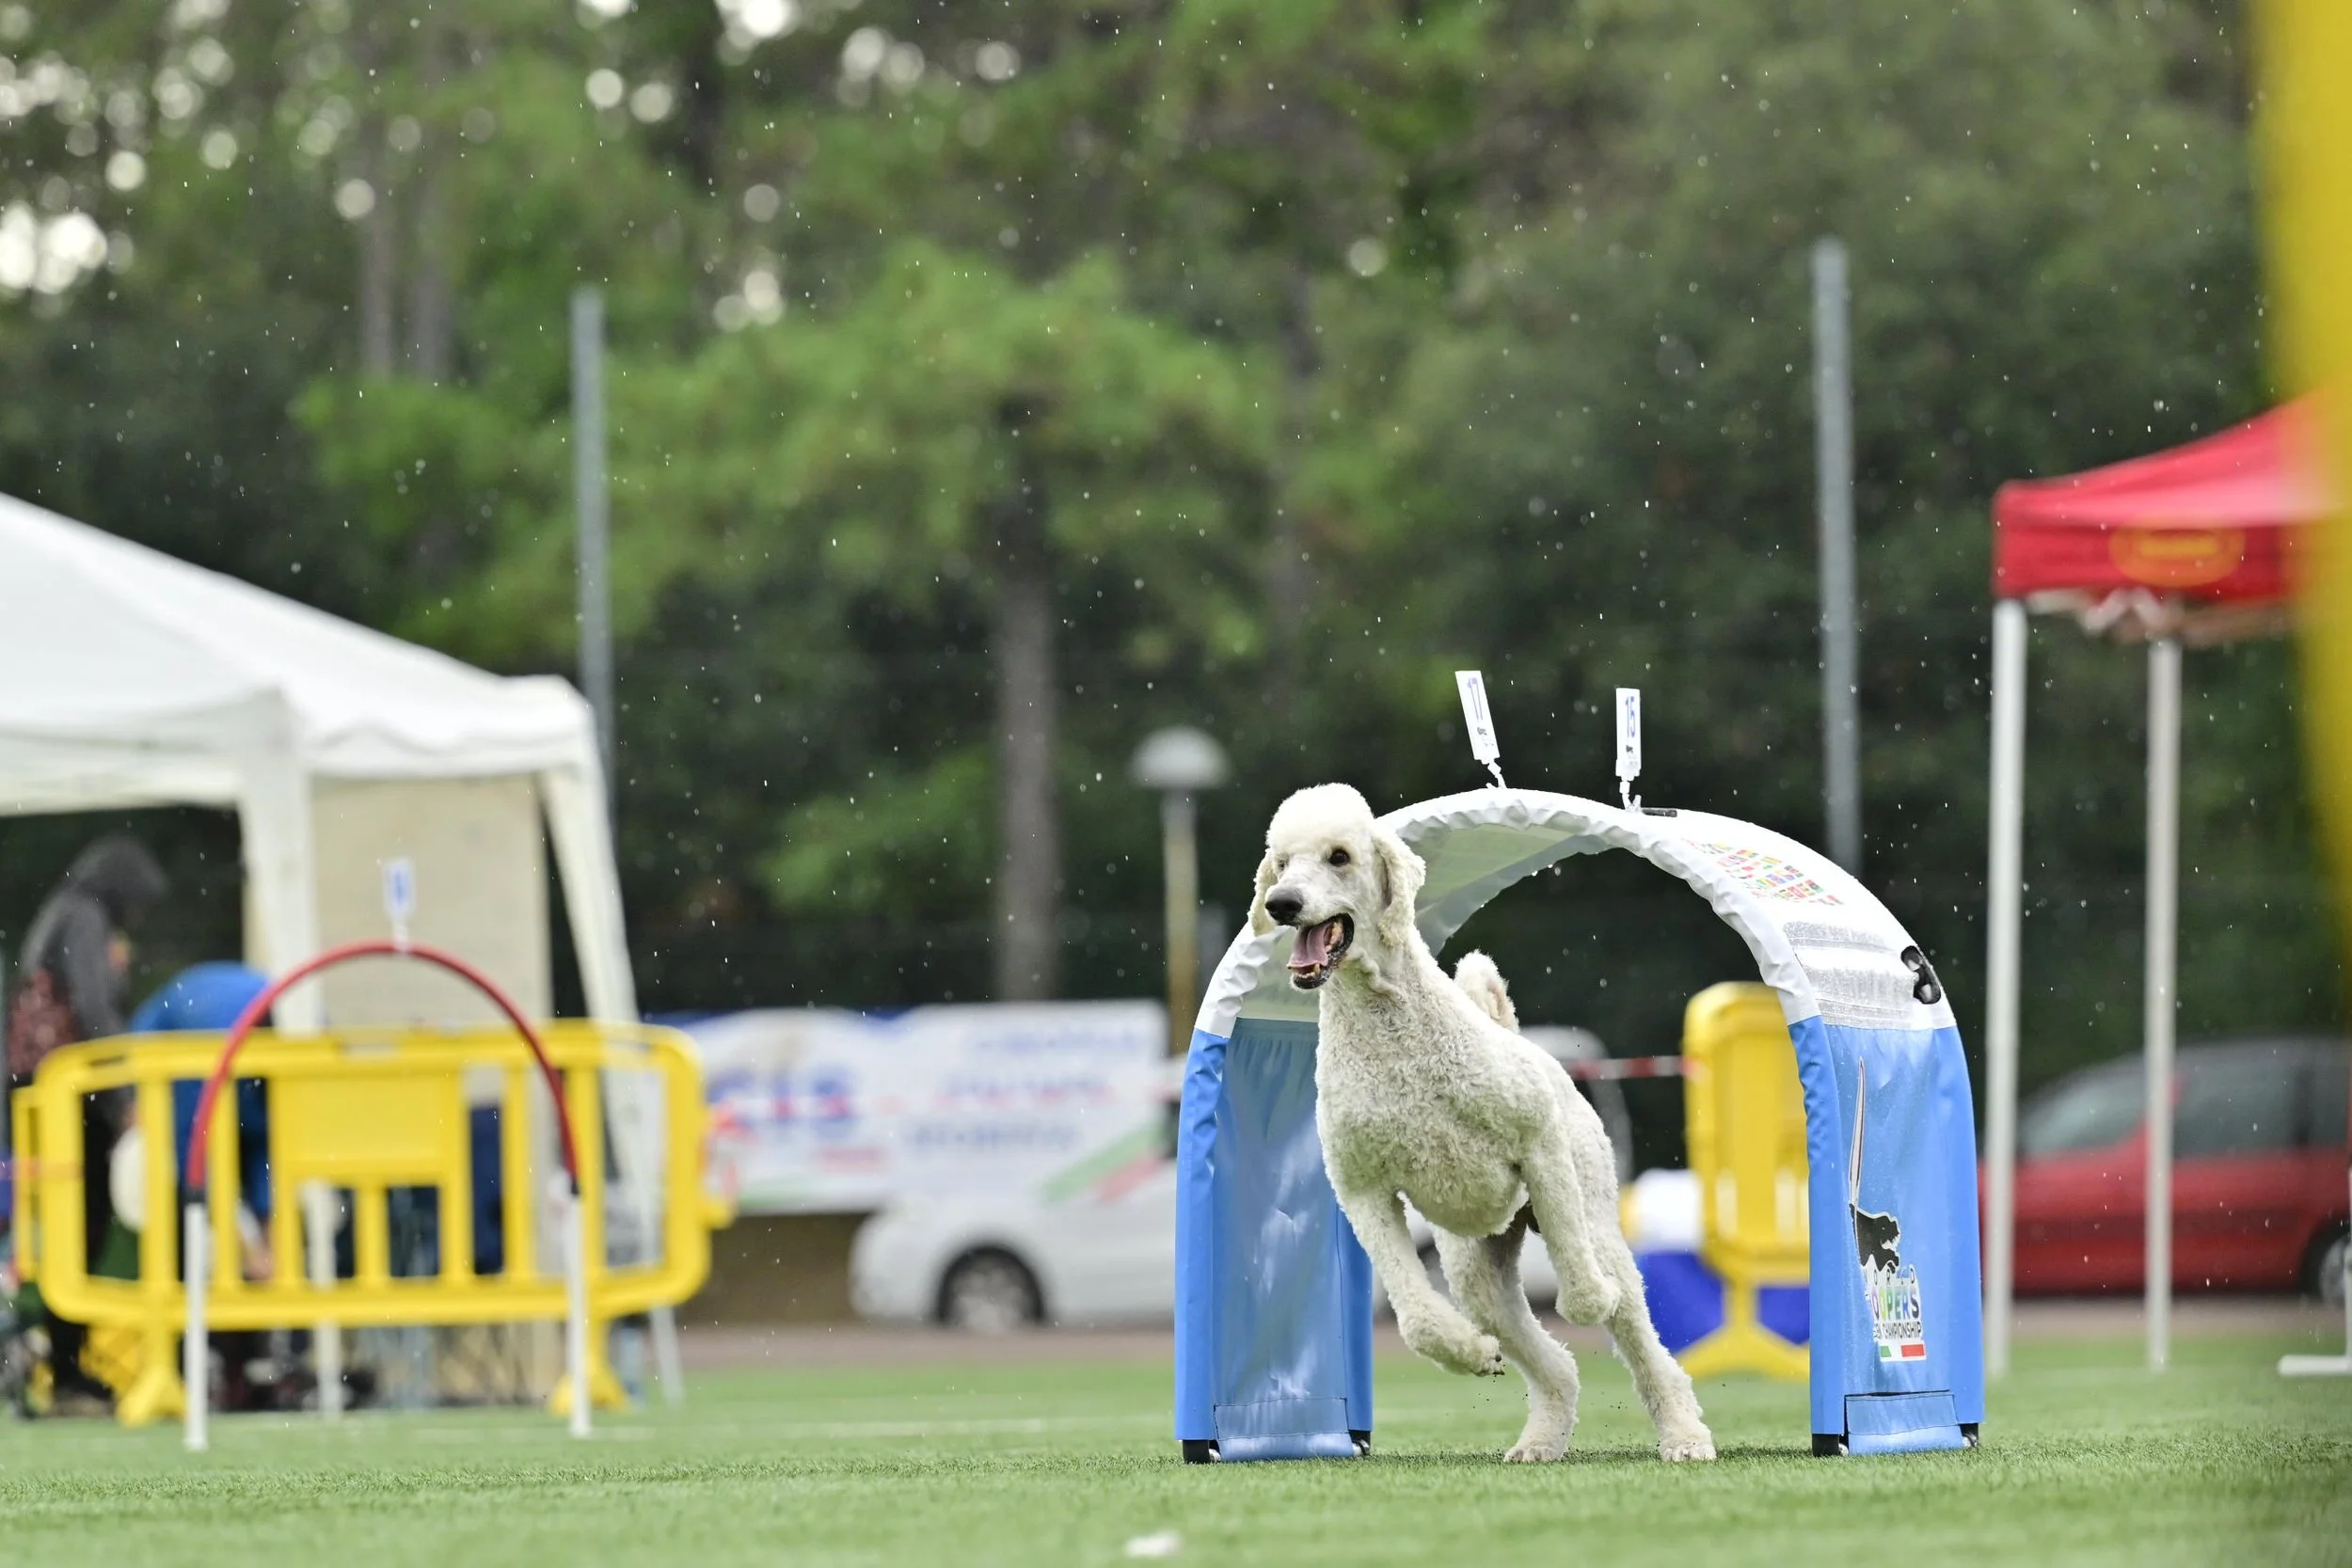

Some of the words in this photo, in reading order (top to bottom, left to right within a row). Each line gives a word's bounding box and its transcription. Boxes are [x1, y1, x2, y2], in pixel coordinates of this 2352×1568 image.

[1625, 695, 1636, 738] 15
[1868, 1287, 1919, 1320] OOPERS
[1883, 1321, 1921, 1339] CHAMPIONSHIP
